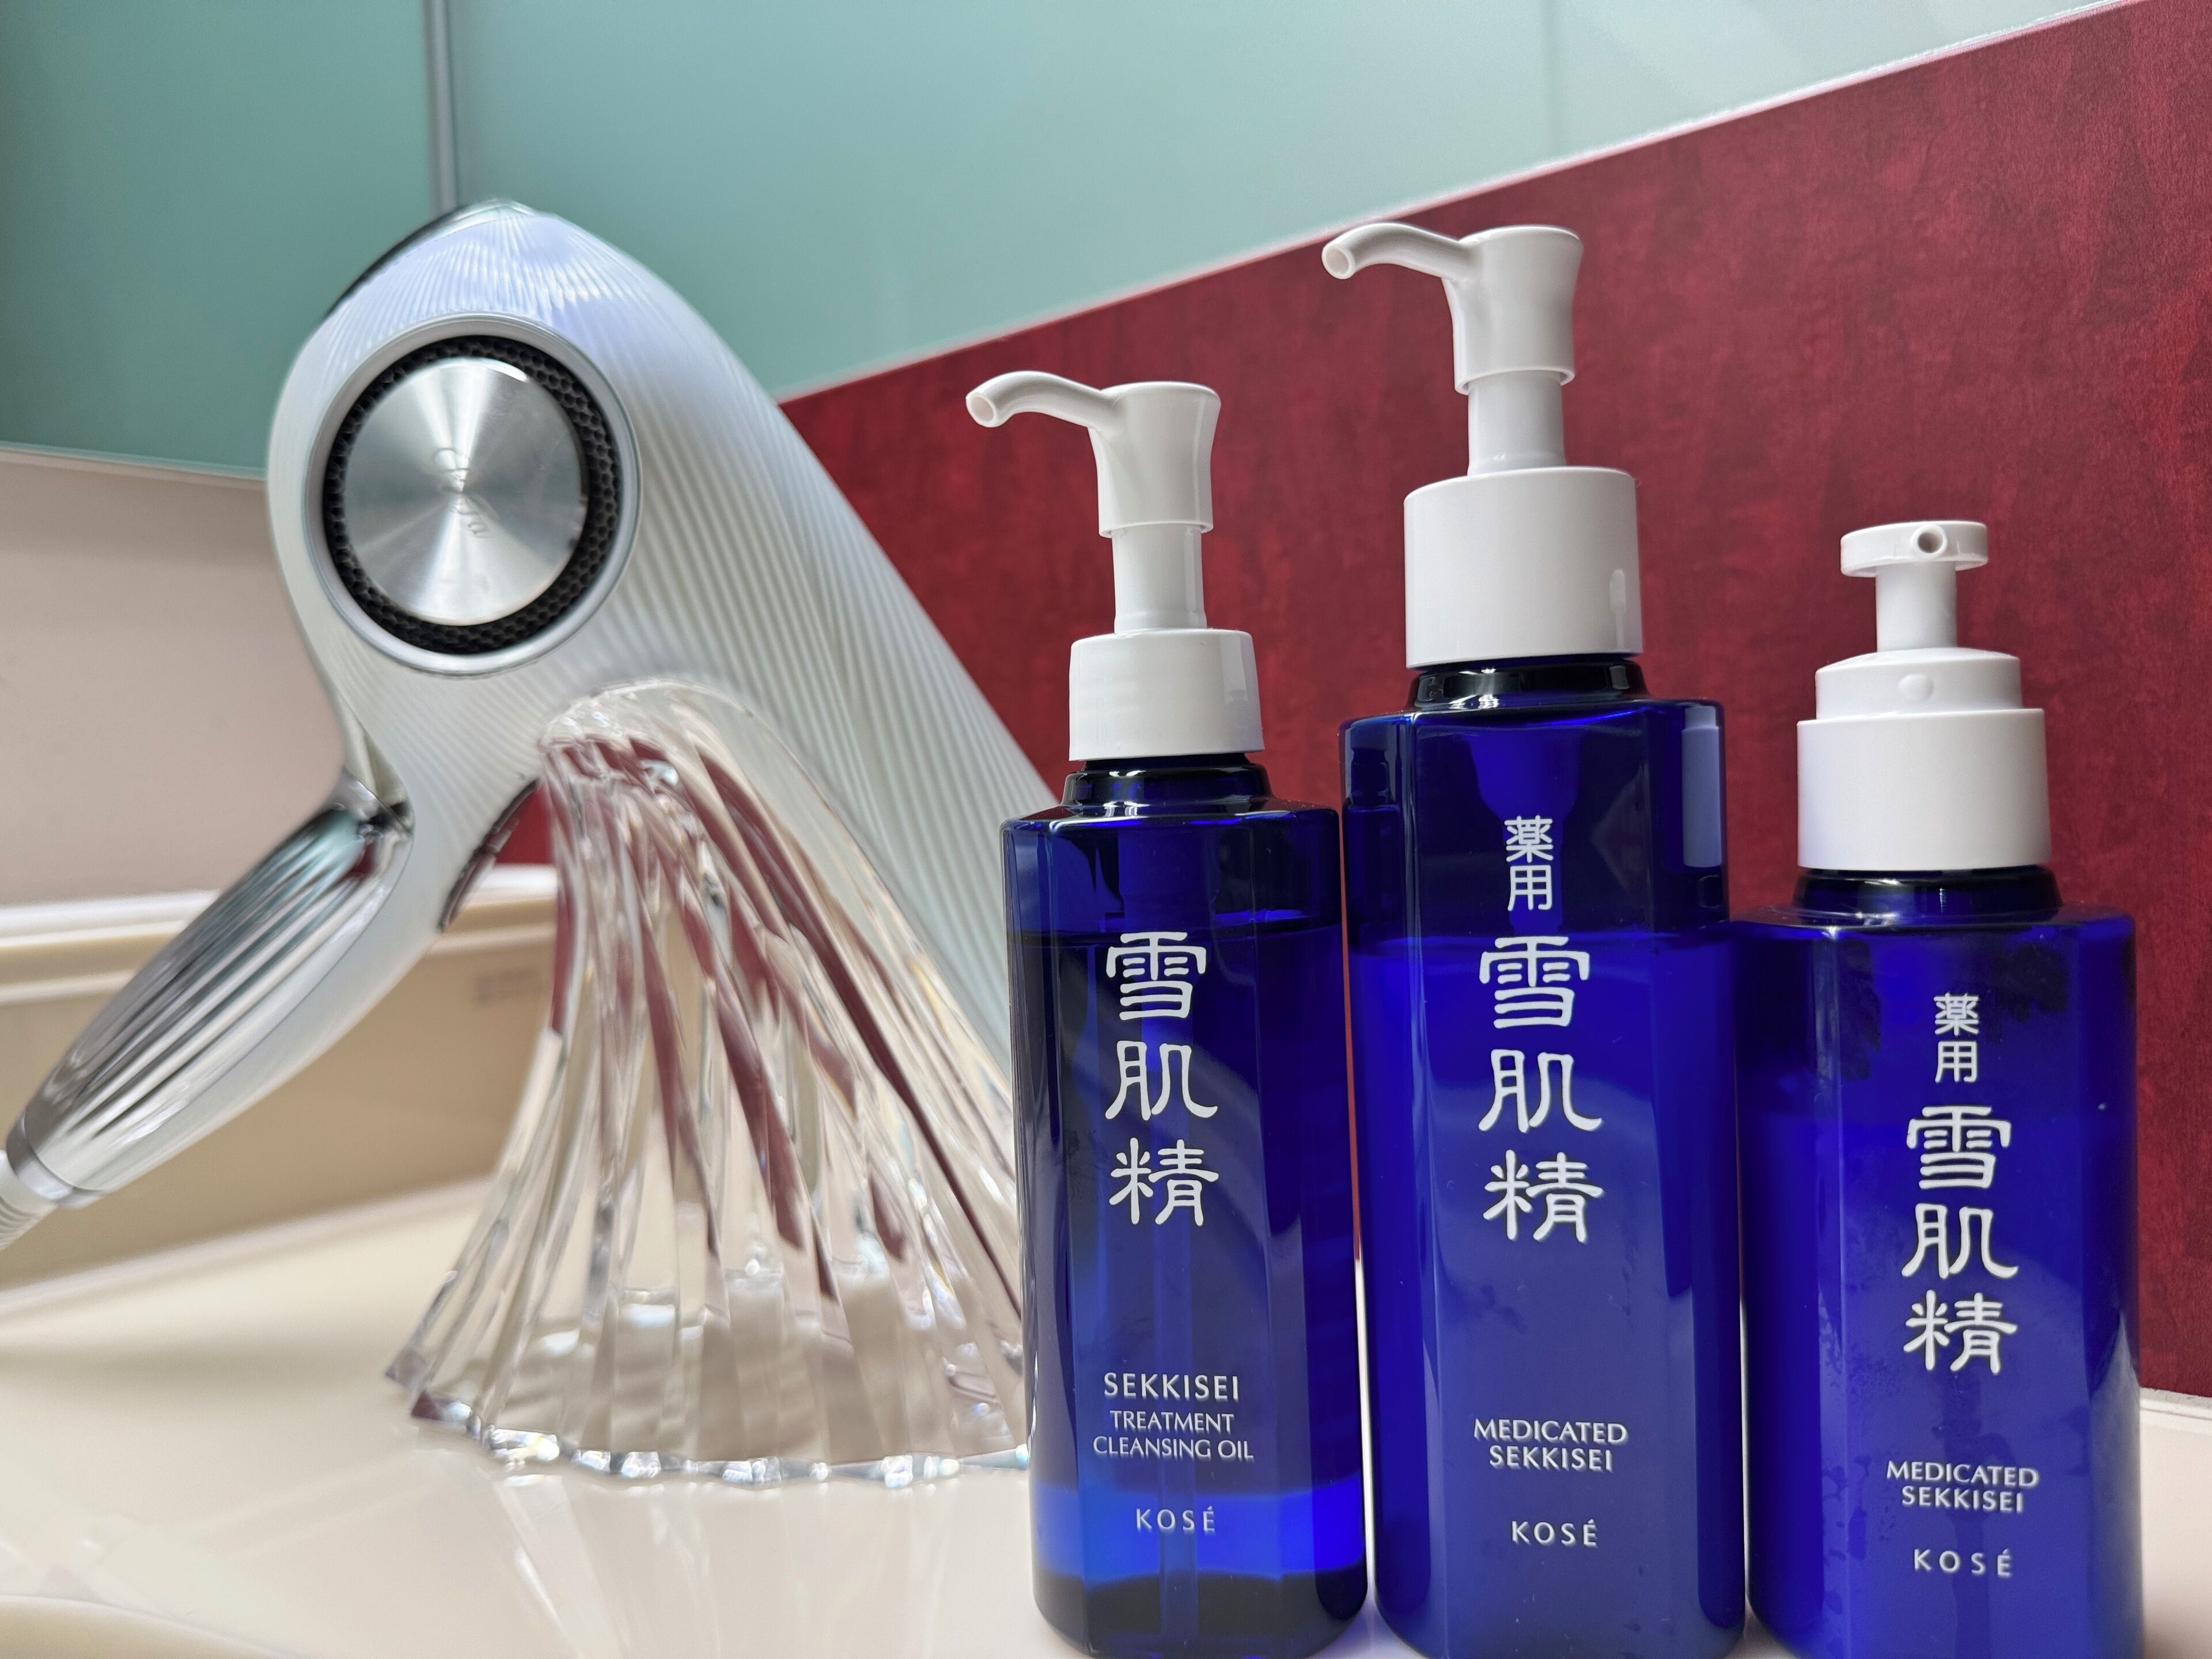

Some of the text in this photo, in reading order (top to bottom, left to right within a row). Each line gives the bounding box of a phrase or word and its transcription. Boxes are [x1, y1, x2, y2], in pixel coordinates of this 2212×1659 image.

[1504, 815, 1555, 912] 薬用
[1934, 992, 1980, 1084] 薬用
[1105, 931, 1219, 1227] 雪肌精
[1478, 935, 1604, 1244] 雪肌精
[1902, 1106, 2019, 1375] 雪肌精
[1104, 1372, 1239, 1400] SEKKISEI
[1109, 1410, 1235, 1434] TREATMENT
[1473, 1418, 1628, 1445] MEDICATED
[1092, 1436, 1255, 1461] CLEANSING OIL
[1489, 1445, 1613, 1472] SEKKISEI
[1887, 1460, 2040, 1489] MEDICATED
[1901, 1486, 2024, 1513] SEKKISEI
[1136, 1506, 1216, 1533] KOSÉ
[1511, 1518, 1599, 1548] KOSÉ
[1913, 1548, 2012, 1577] KOSÉ
